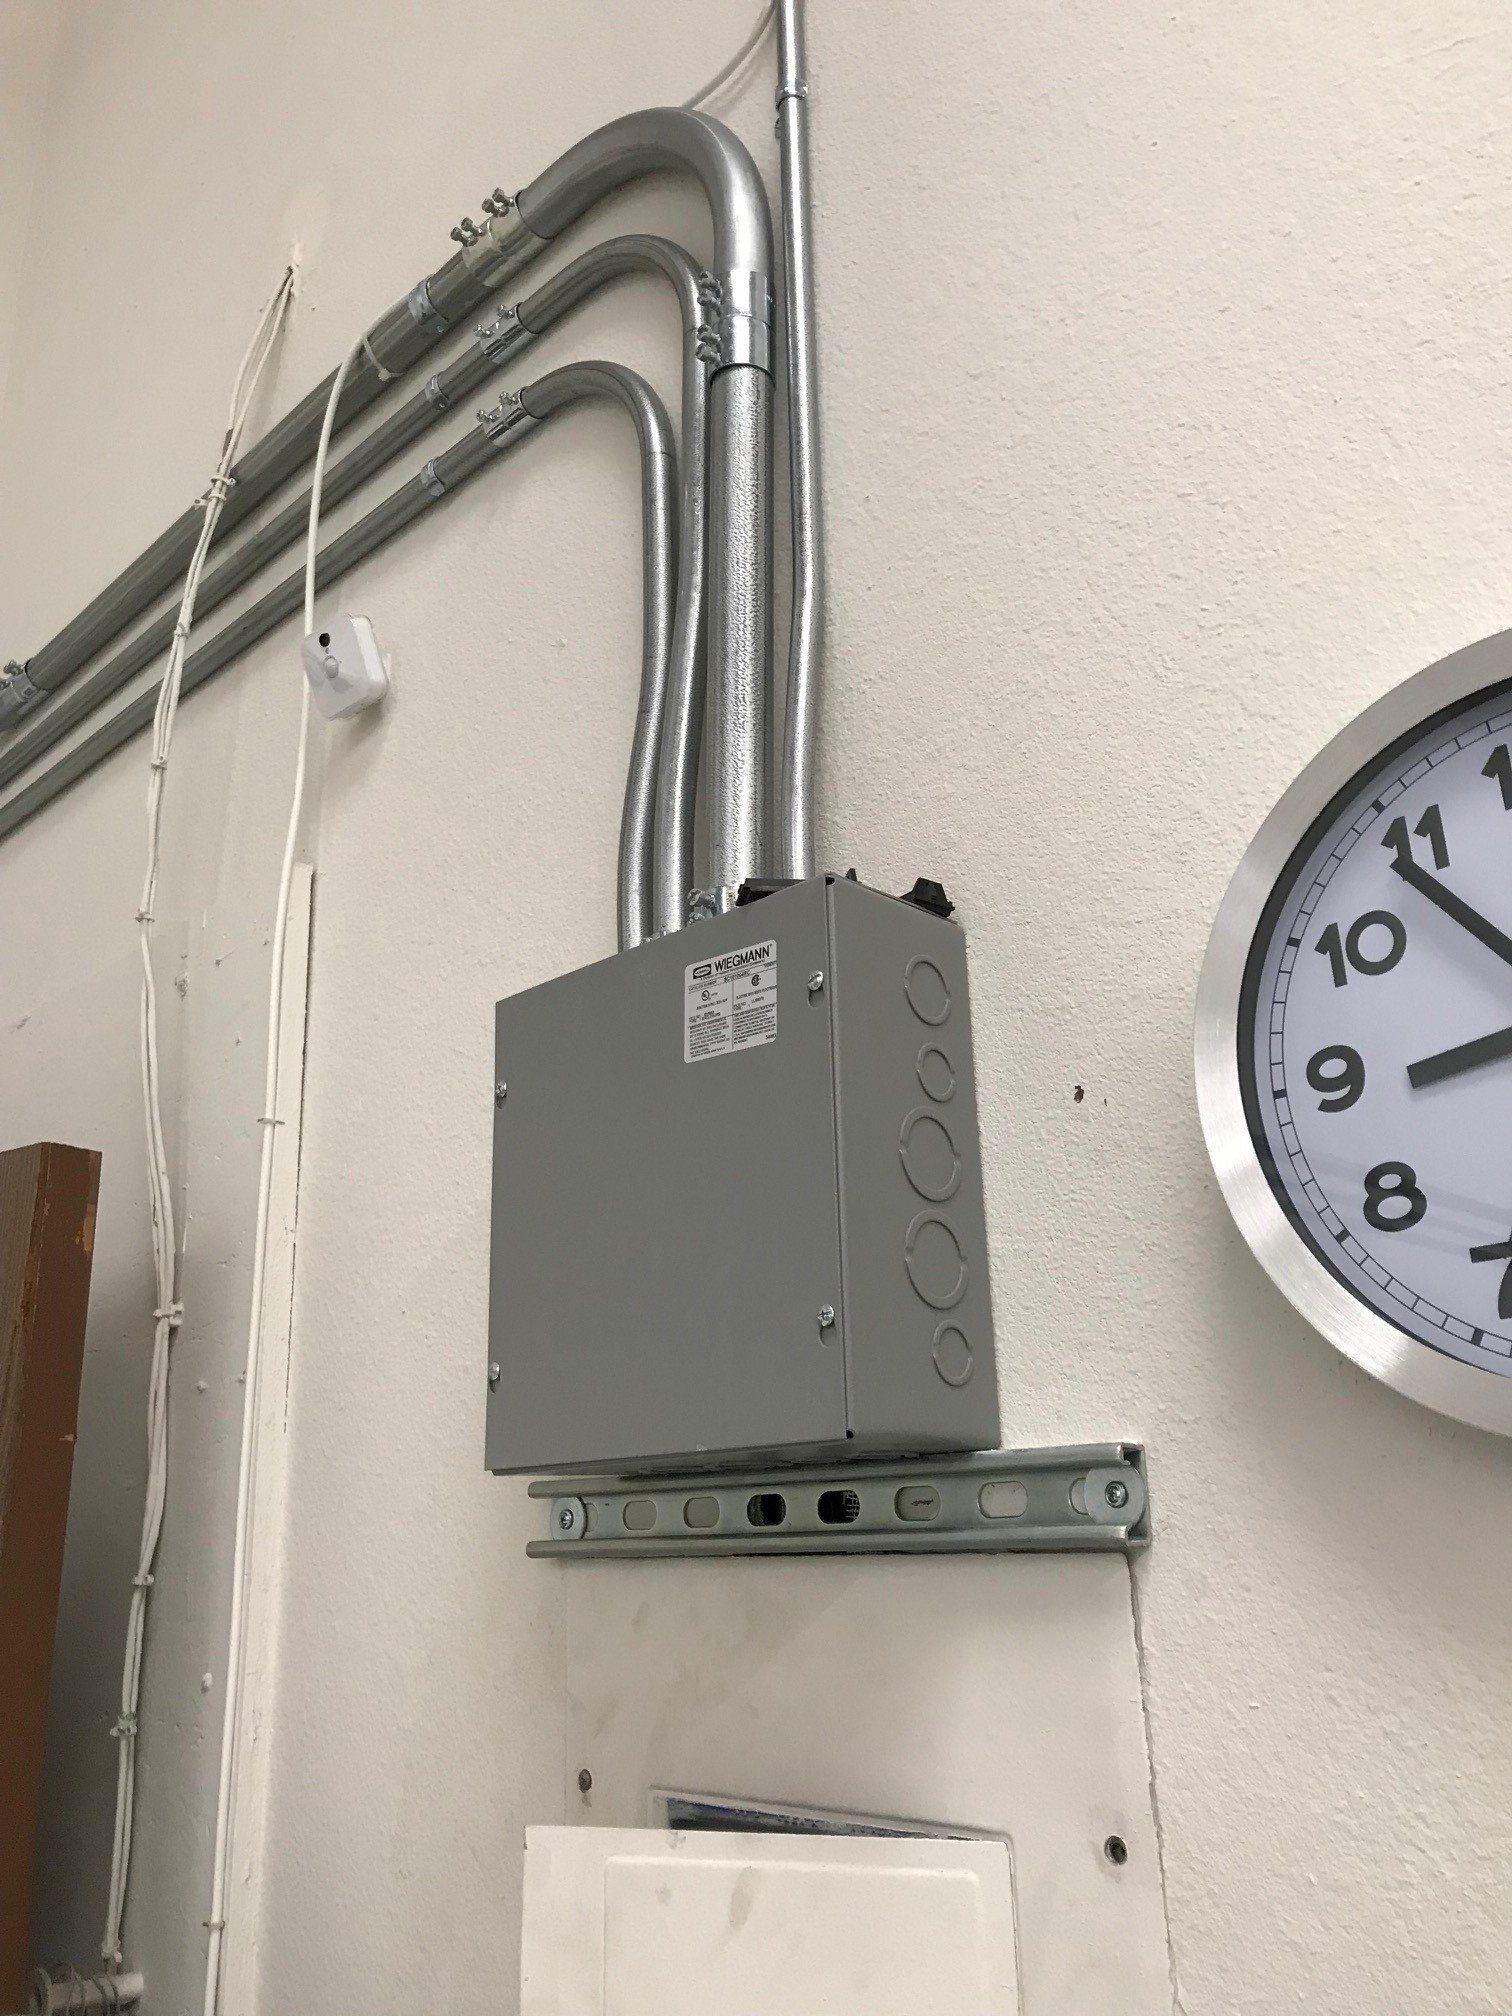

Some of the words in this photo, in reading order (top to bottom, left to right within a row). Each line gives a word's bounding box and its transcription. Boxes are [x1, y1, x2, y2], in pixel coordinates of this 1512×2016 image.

[1481, 744, 1512, 811] 1
[1380, 804, 1451, 882] 11
[714, 945, 771, 972] WIEGMANN
[1314, 910, 1407, 988] 10
[1305, 1044, 1366, 1113] 9
[1362, 1160, 1428, 1233] 8
